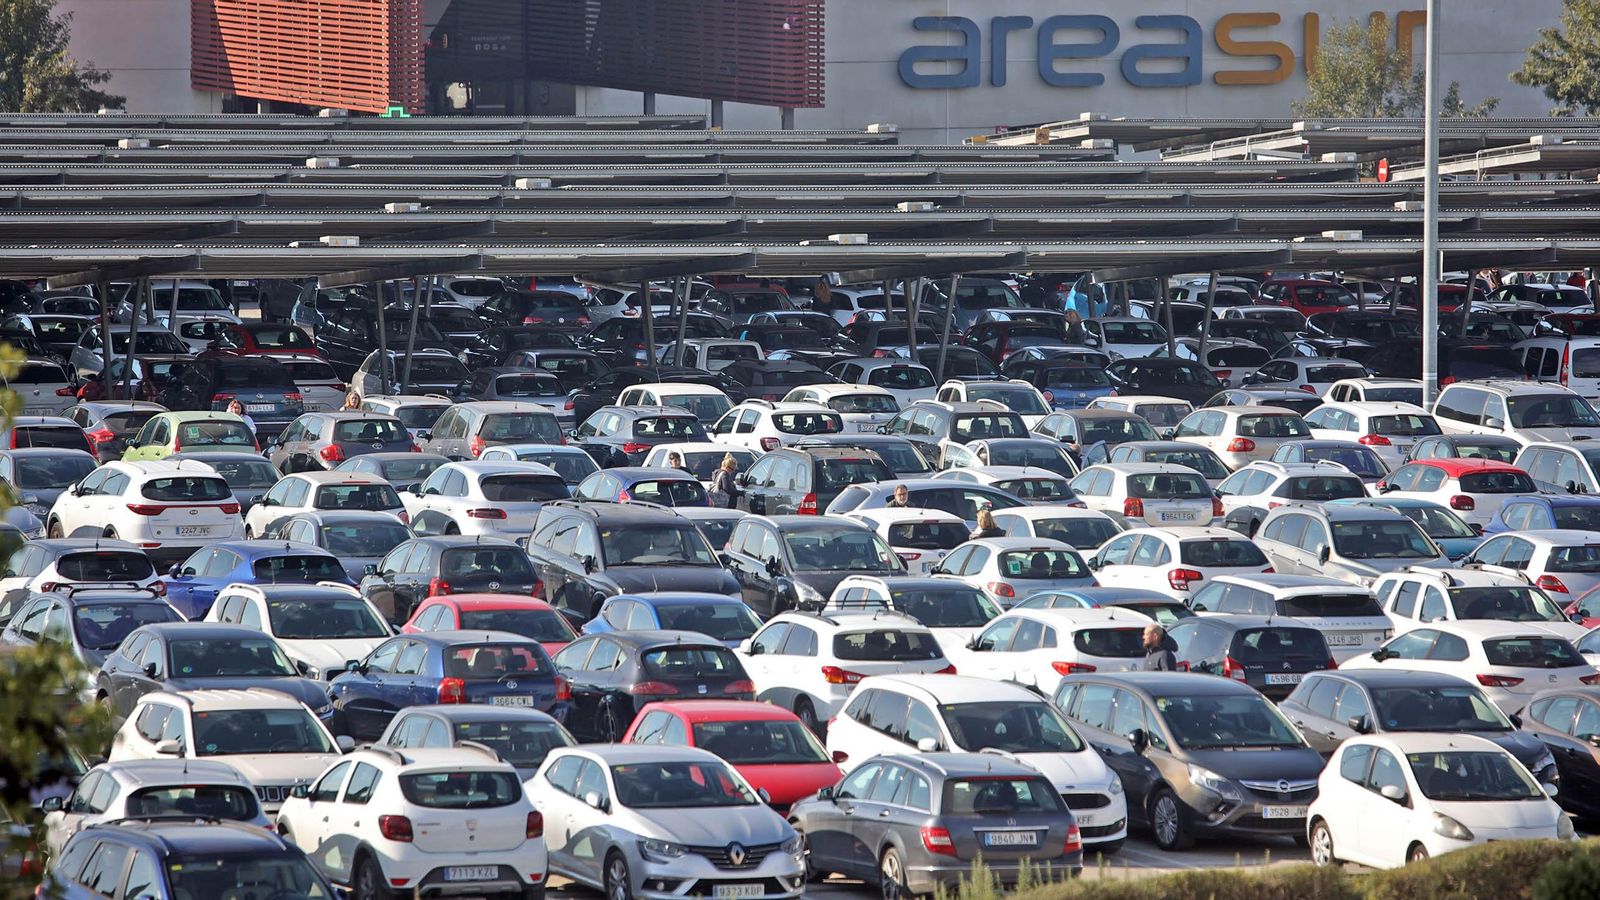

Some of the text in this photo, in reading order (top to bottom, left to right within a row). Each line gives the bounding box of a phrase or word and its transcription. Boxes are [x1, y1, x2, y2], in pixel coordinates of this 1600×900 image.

[1270, 674, 1303, 685] 4596 GB
[1270, 807, 1290, 817] 3528
[991, 833, 1015, 845] 9840
[451, 867, 496, 879] 7113 KZL
